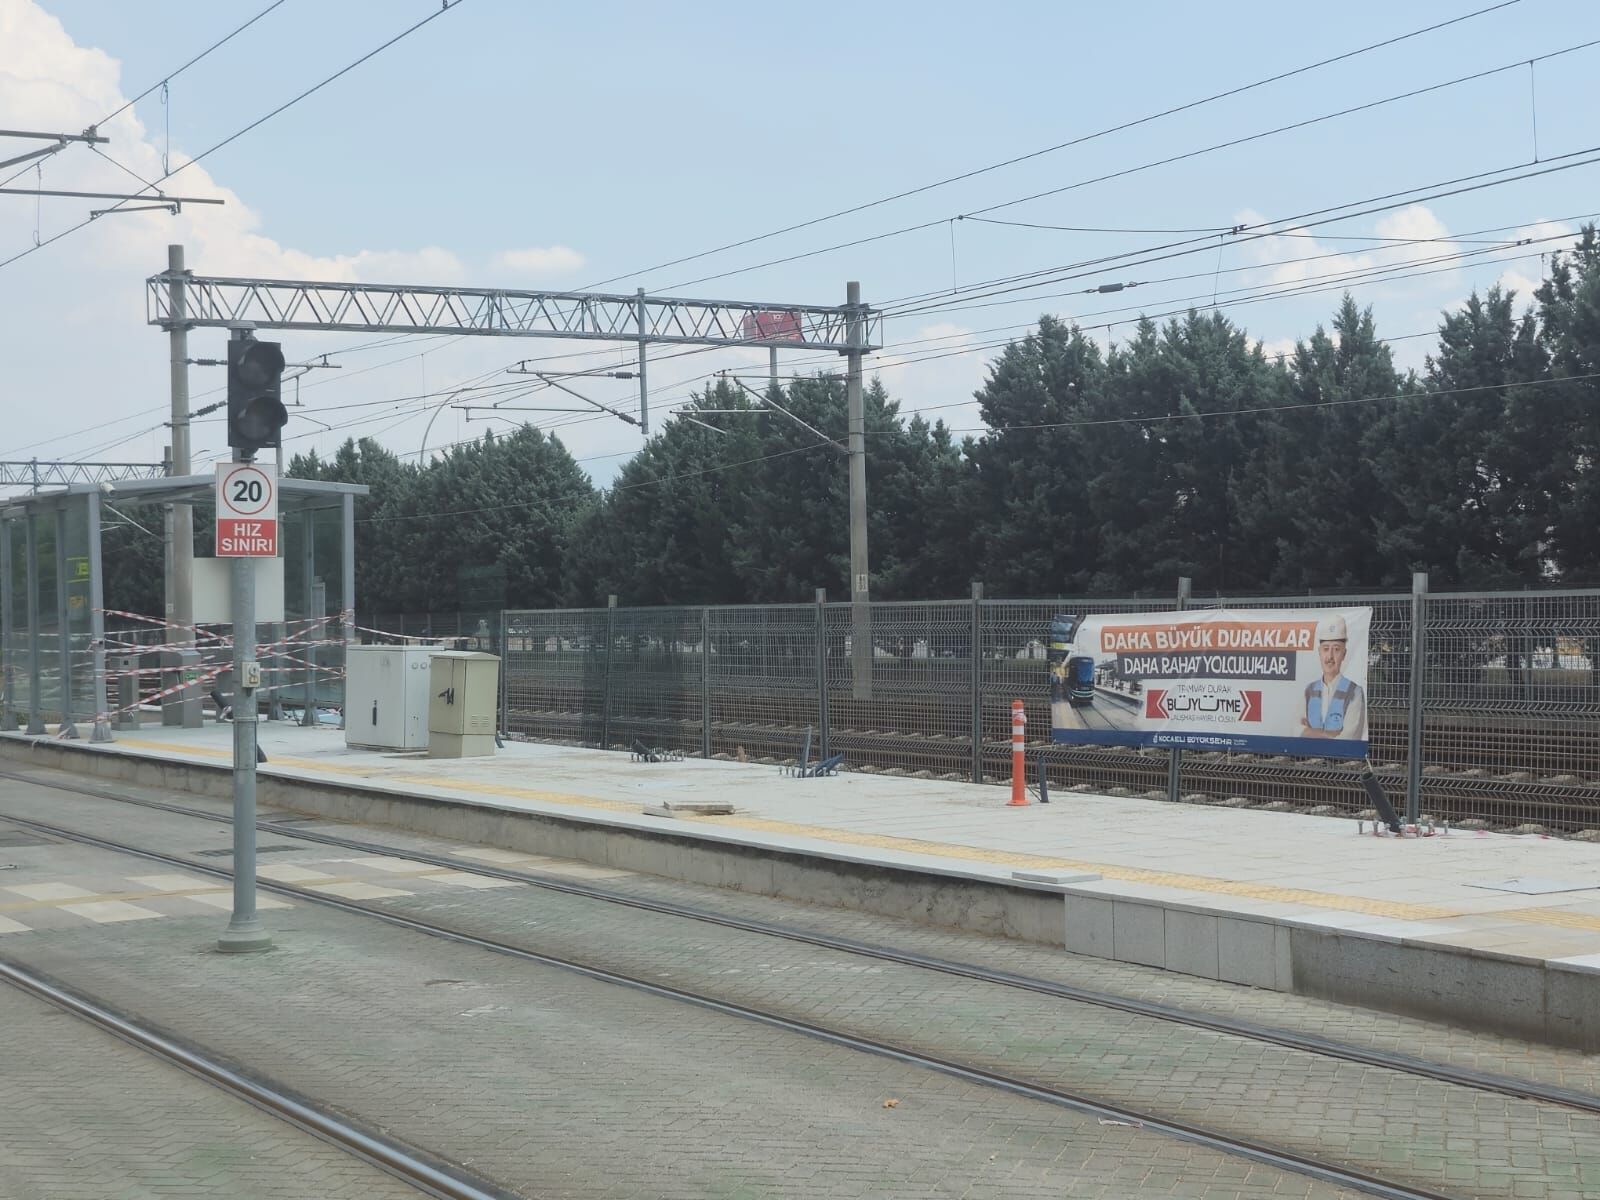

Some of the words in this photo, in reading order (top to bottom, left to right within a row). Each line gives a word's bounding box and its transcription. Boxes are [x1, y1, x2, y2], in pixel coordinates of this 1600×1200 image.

[233, 480, 262, 502] 20
[234, 523, 262, 537] HIZ
[222, 538, 273, 552] SINIRI
[1104, 631, 1152, 650] DAHA
[1155, 626, 1214, 648] BÜYÜK
[1217, 628, 1310, 648] DURAKLAR
[1124, 656, 1159, 674] DAHA
[1161, 656, 1202, 674] RAHAT
[1203, 656, 1288, 674] YOLCULUKLAR
[1167, 694, 1241, 713] BÜYÜTME
